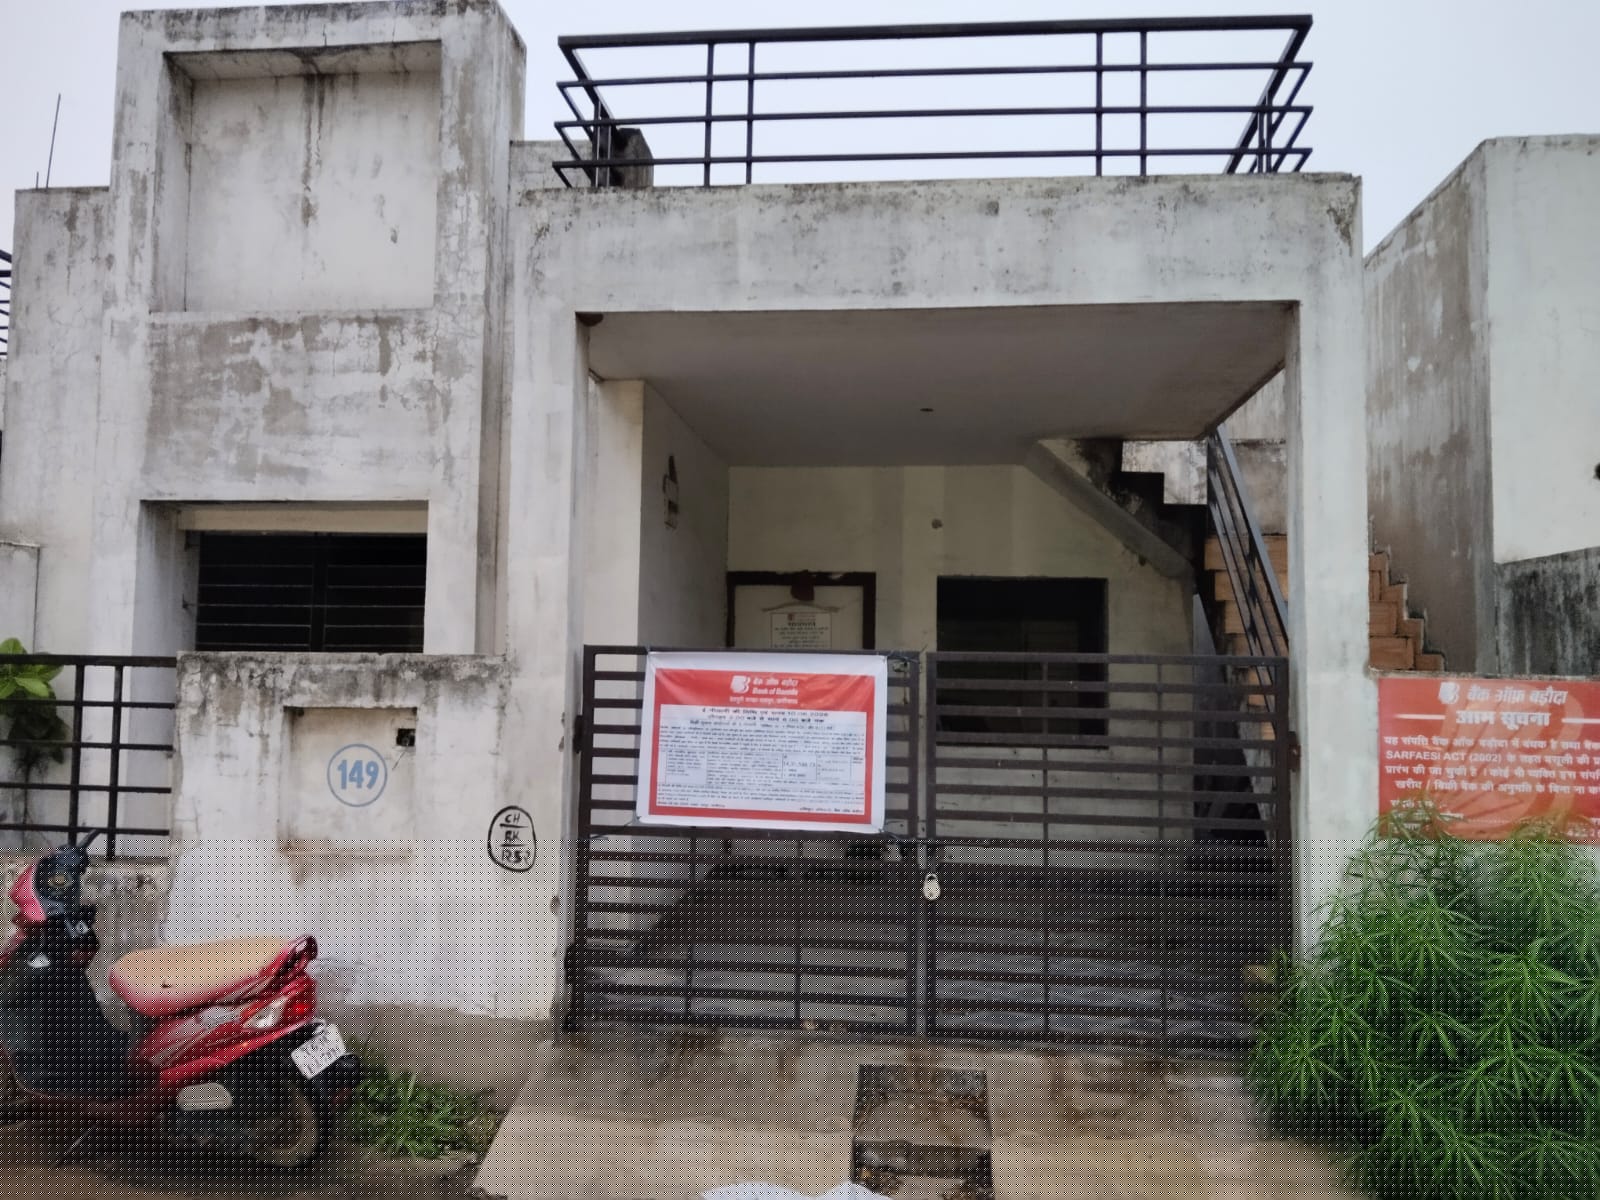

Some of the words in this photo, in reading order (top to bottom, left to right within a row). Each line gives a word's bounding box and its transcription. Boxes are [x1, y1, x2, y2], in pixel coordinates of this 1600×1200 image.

[1529, 684, 1568, 705] बड़ौदा
[1456, 710, 1497, 725] आम
[1500, 711, 1551, 731] सूचना
[1384, 736, 1398, 746] यह
[1385, 750, 1441, 761] SARFAESI
[1443, 751, 1466, 762] ACT
[1470, 752, 1502, 764] (2002)
[338, 759, 379, 790] 149
[504, 812, 521, 823] CH
